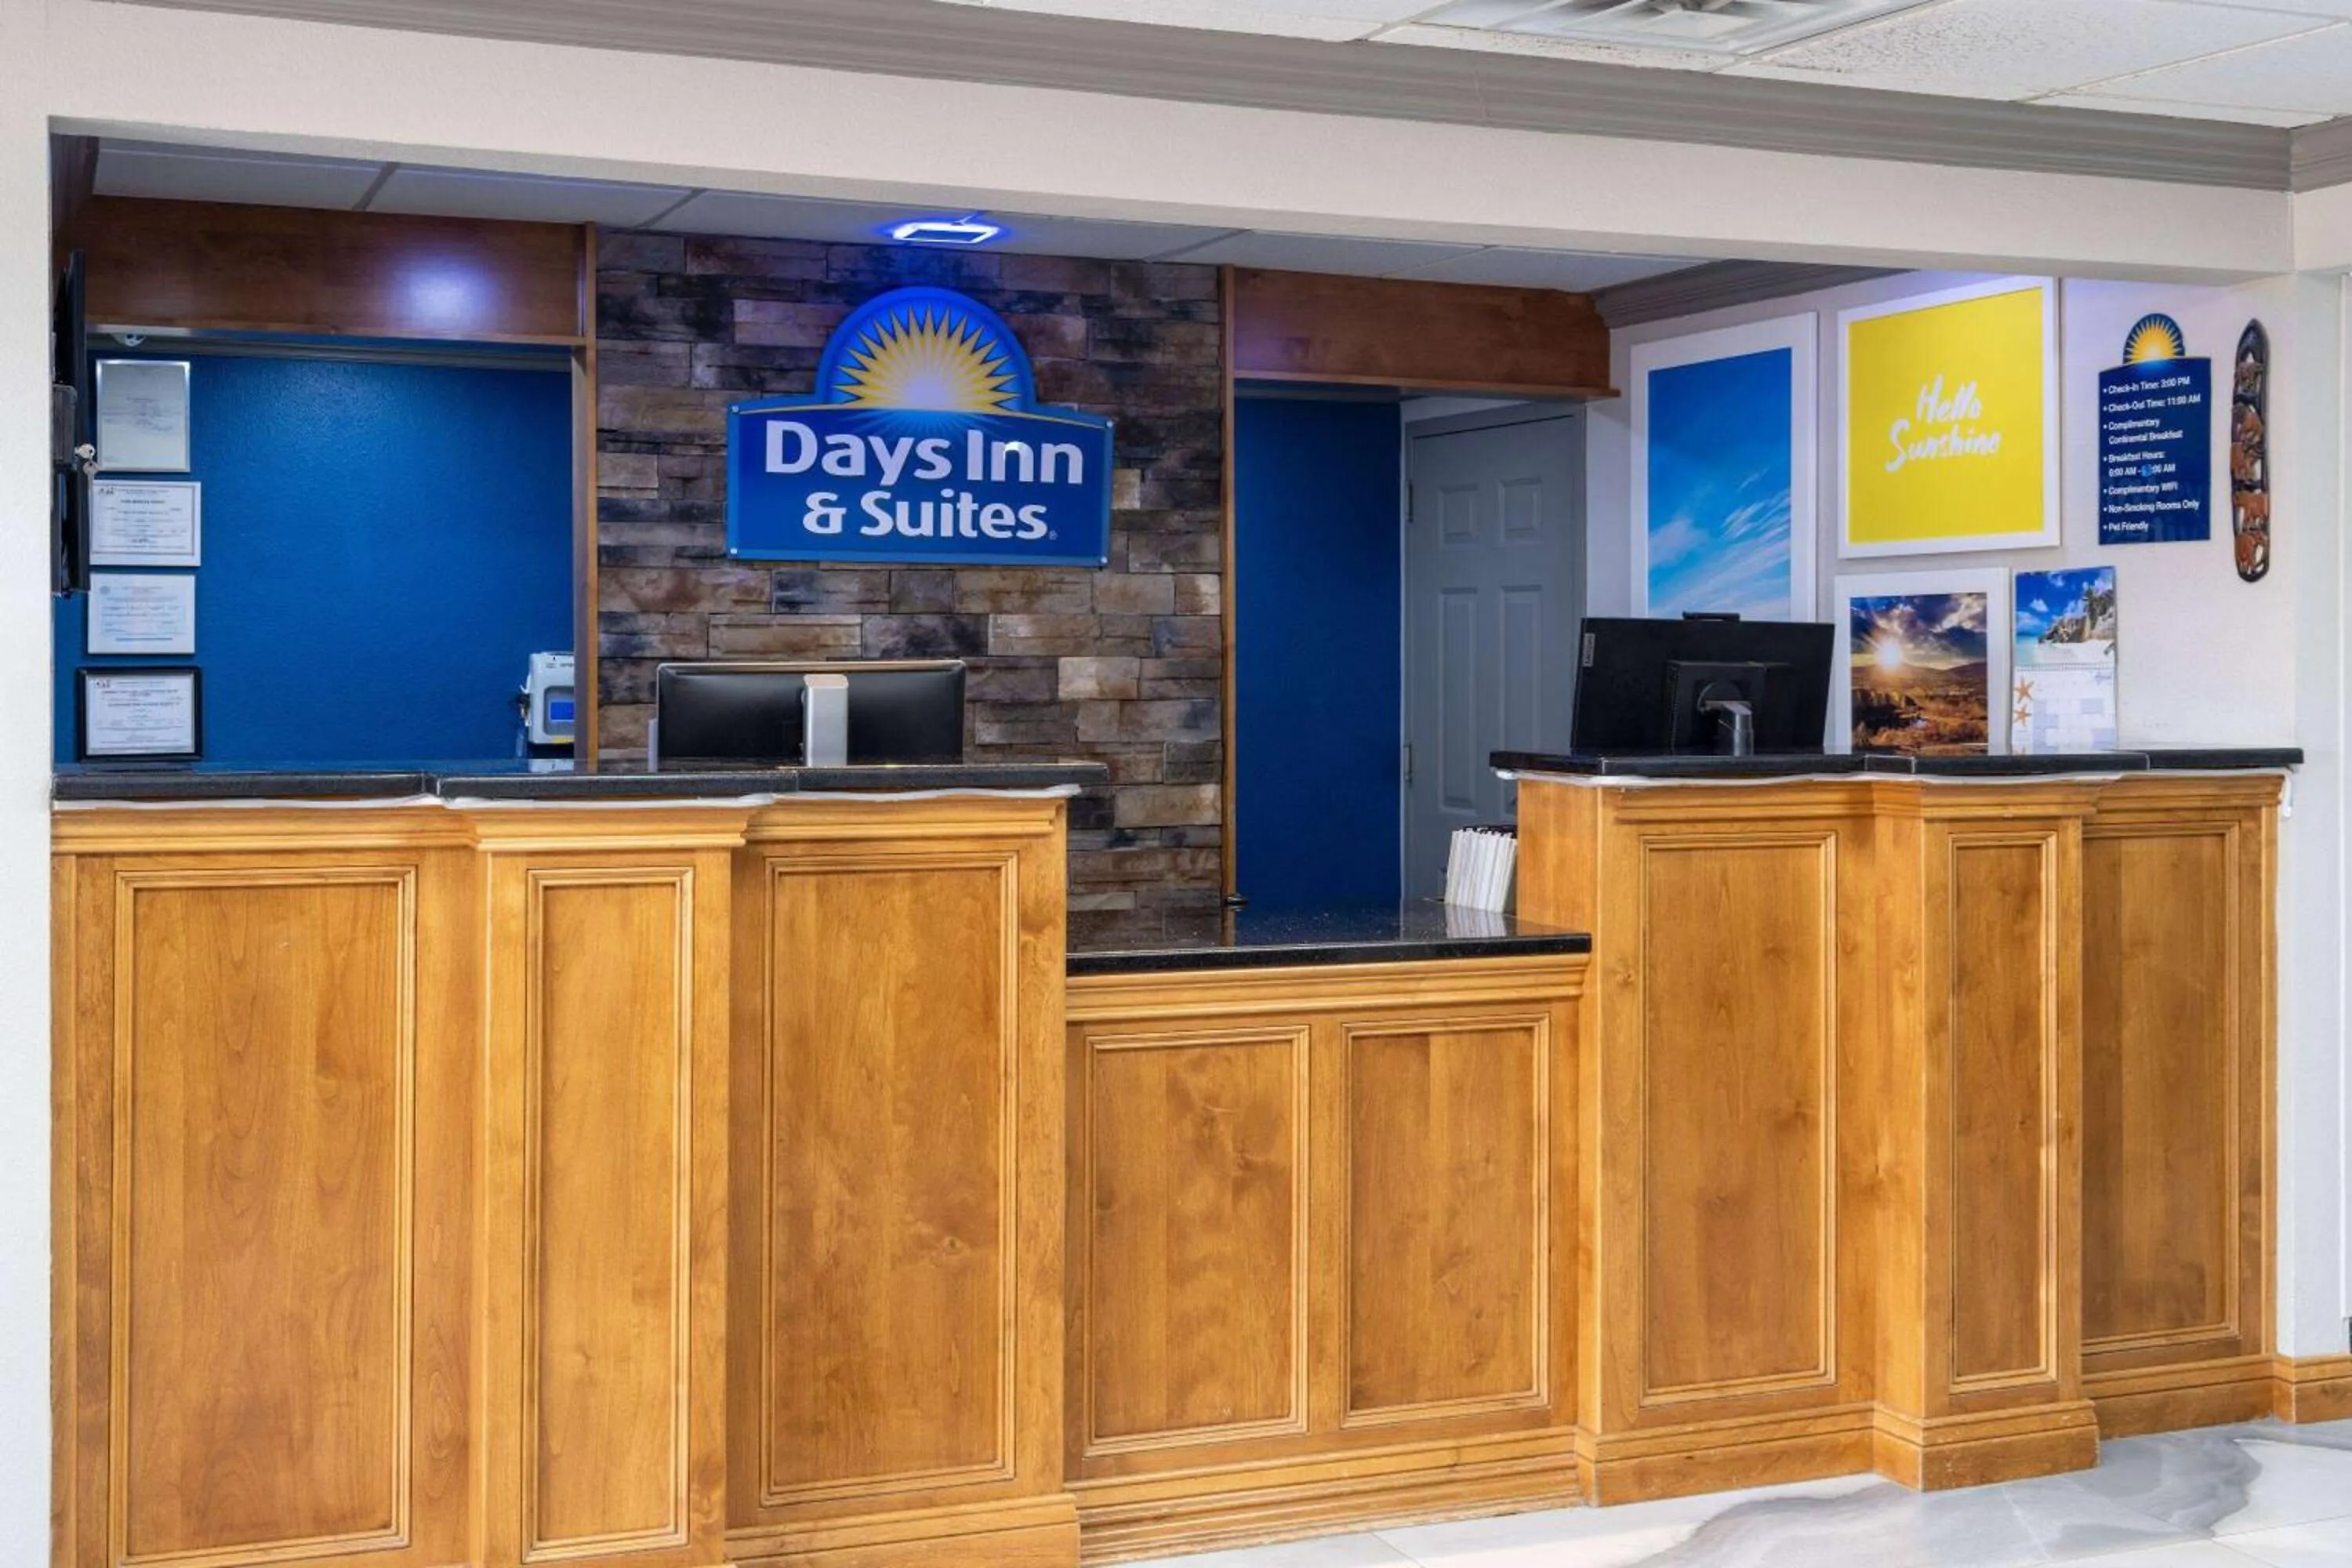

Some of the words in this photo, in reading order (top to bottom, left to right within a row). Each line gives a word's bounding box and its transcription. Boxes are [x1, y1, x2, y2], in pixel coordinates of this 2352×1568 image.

[2161, 378, 2176, 388] 3:00
[2178, 376, 2190, 386] PM
[1916, 374, 1982, 423] Hello
[2167, 395, 2186, 405] 11:00
[2188, 393, 2201, 403] AM
[1885, 418, 2001, 472] Sunshine
[765, 419, 953, 486] Days
[967, 429, 1083, 485] Inn
[2125, 466, 2136, 475] AM
[2163, 463, 2176, 473] AM
[2156, 501, 2181, 510] Rooms
[2182, 499, 2200, 511] Only
[802, 492, 847, 535] &
[859, 488, 1047, 539] Suites
[2122, 521, 2149, 532] Friendly
